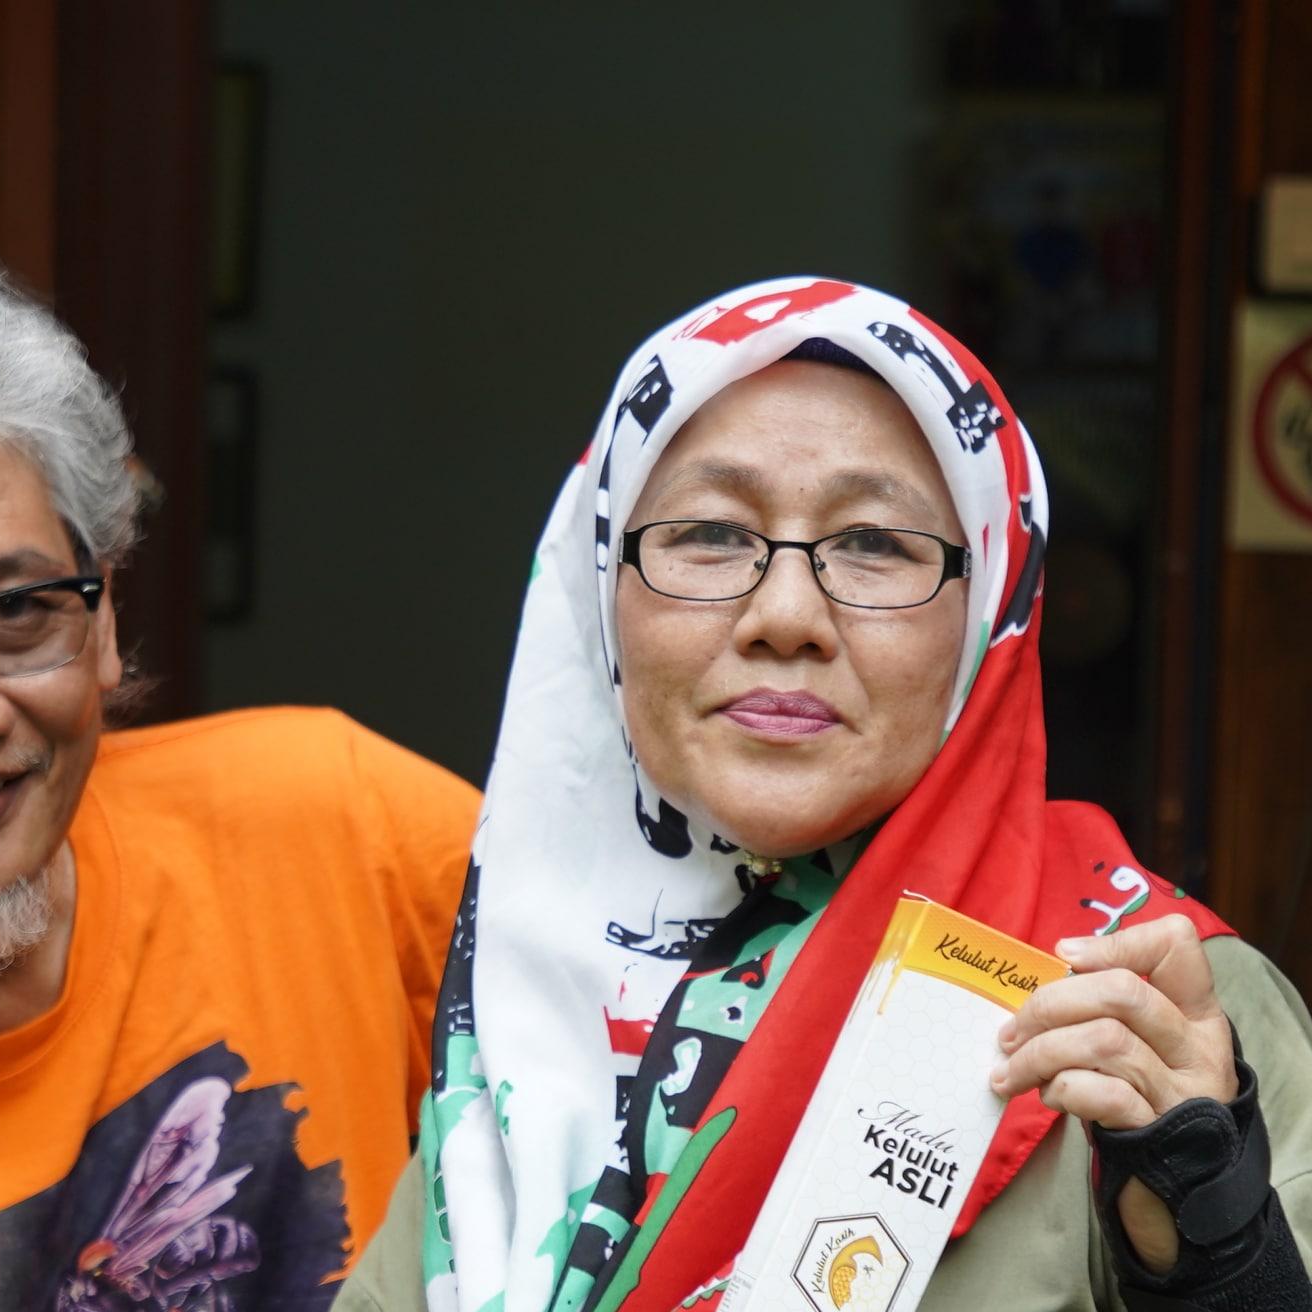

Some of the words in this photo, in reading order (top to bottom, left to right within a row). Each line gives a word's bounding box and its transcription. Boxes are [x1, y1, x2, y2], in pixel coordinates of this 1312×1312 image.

[934, 933, 994, 974] Kelulut
[992, 959, 1039, 993] Kasih
[857, 1101, 956, 1153] Madu
[863, 1124, 959, 1182] Kelulut
[869, 1158, 954, 1210] ASLI
[812, 1251, 829, 1294] Kelulut
[825, 1228, 856, 1253] Kasih
